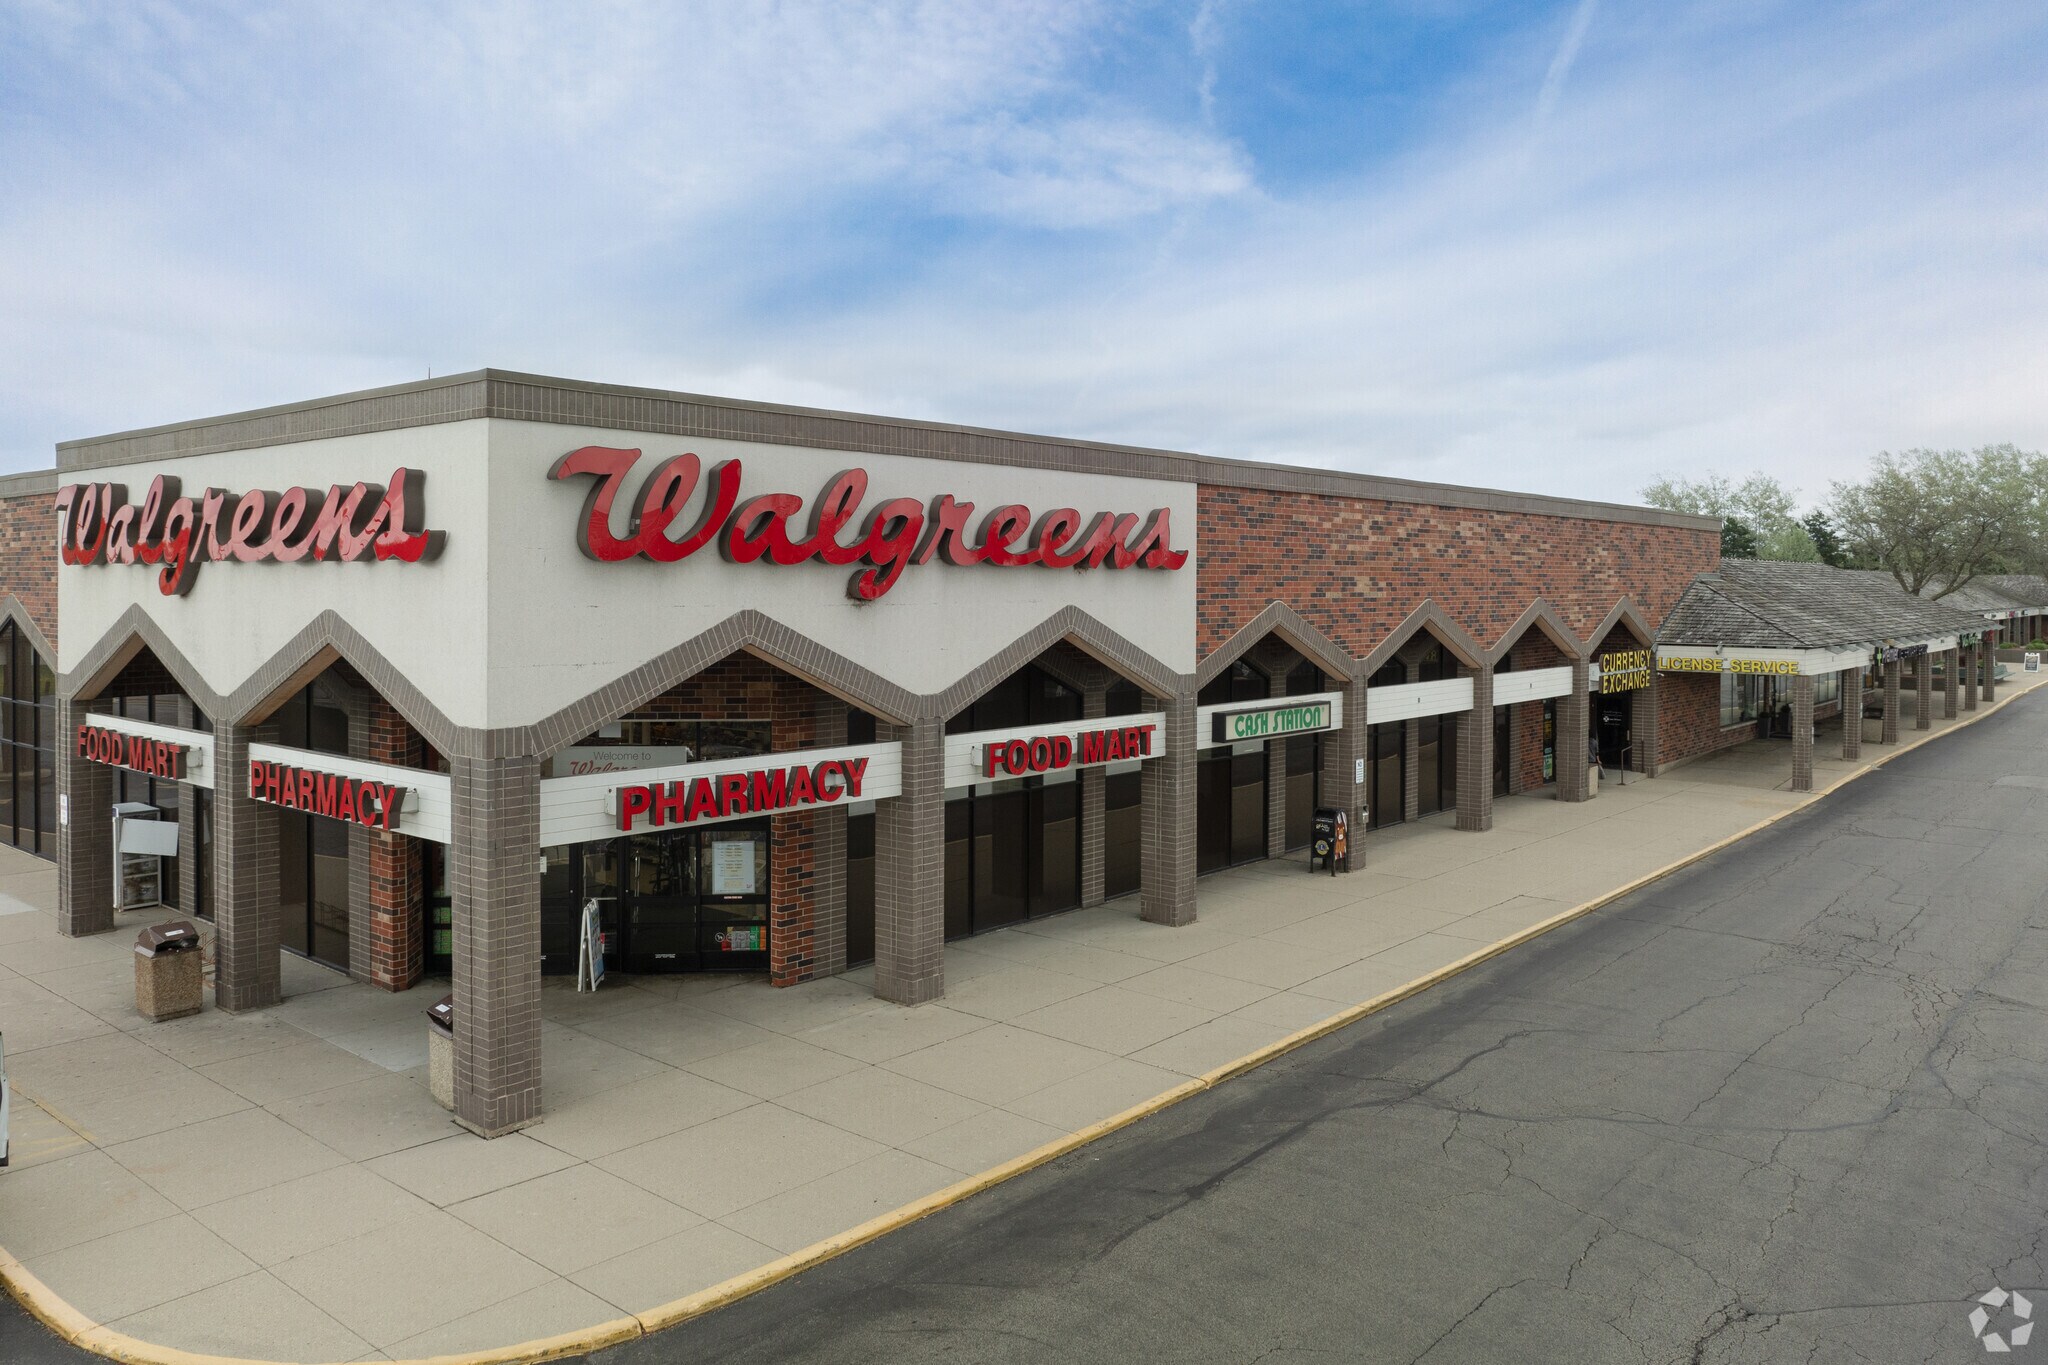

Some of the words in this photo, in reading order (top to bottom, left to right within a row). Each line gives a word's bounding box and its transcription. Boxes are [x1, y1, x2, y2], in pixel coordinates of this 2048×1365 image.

[55, 467, 442, 596] Walgreens
[547, 446, 1189, 600] Walgreens
[1602, 650, 1651, 673] CURRENCY
[1602, 670, 1651, 694] EXCHANGE
[1658, 656, 1723, 672] LICENSE
[1730, 660, 1800, 675] SERVICE
[1234, 713, 1269, 737] CASH
[1273, 706, 1321, 732] STATION
[77, 724, 125, 765] FOOD
[128, 735, 183, 780] MART
[593, 751, 639, 761] Welcome
[641, 751, 652, 761] to
[984, 735, 1073, 778] FOOD
[1078, 724, 1156, 764] MART
[251, 760, 402, 831] PHARMACY
[617, 757, 869, 831] PHARMACY
